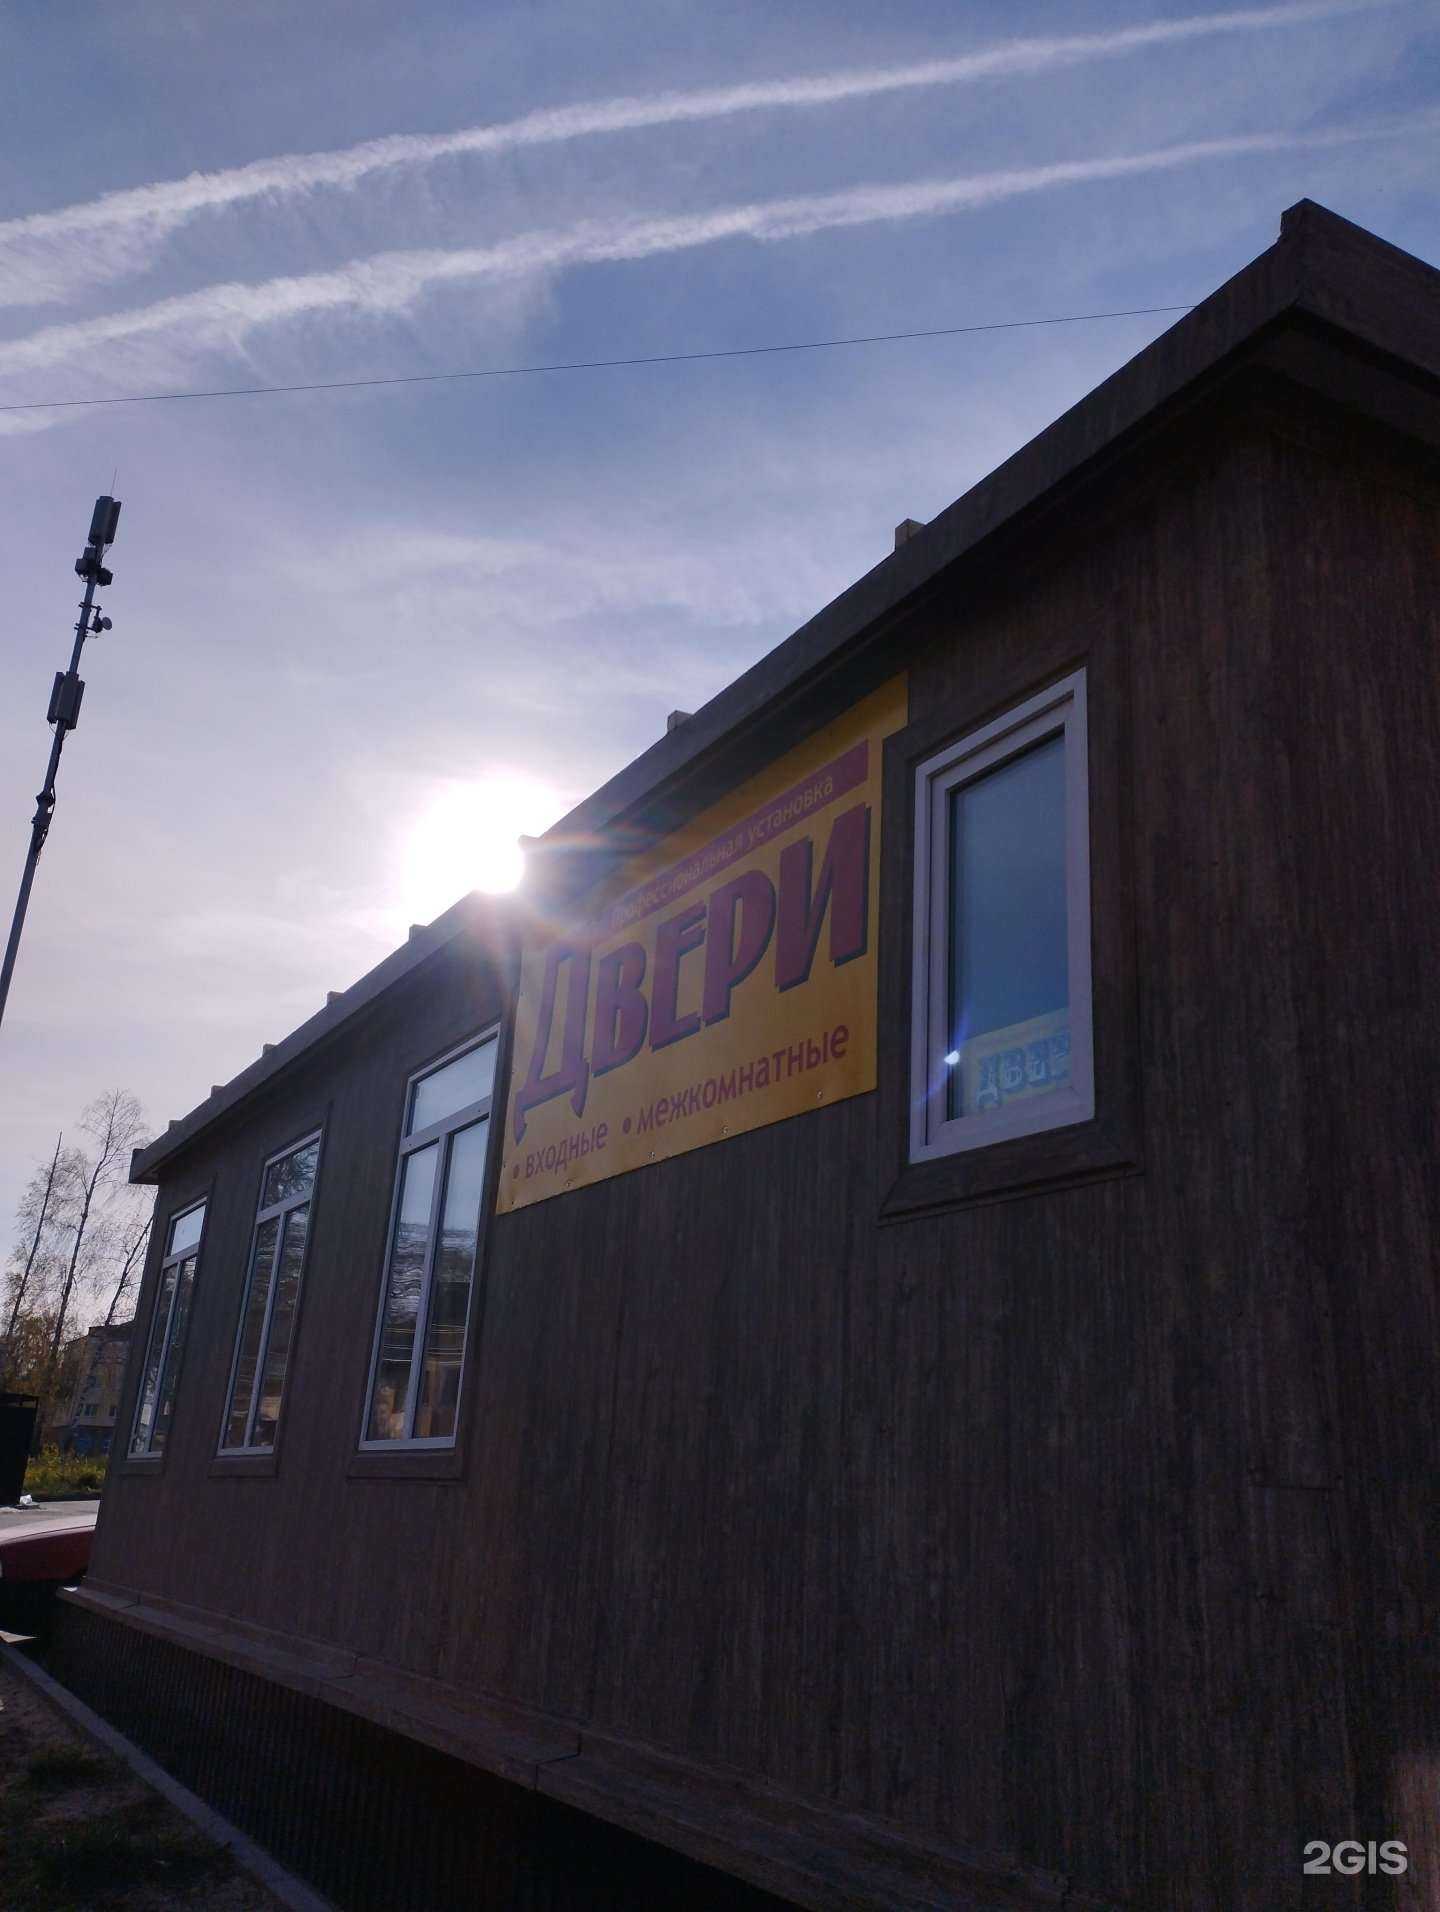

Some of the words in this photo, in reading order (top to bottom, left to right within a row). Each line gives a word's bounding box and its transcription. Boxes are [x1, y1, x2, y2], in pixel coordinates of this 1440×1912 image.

[748, 776, 834, 850] установка
[514, 802, 872, 1144] ДВЕРИ
[525, 1120, 609, 1179] входные
[637, 1025, 850, 1135] межкомнатные
